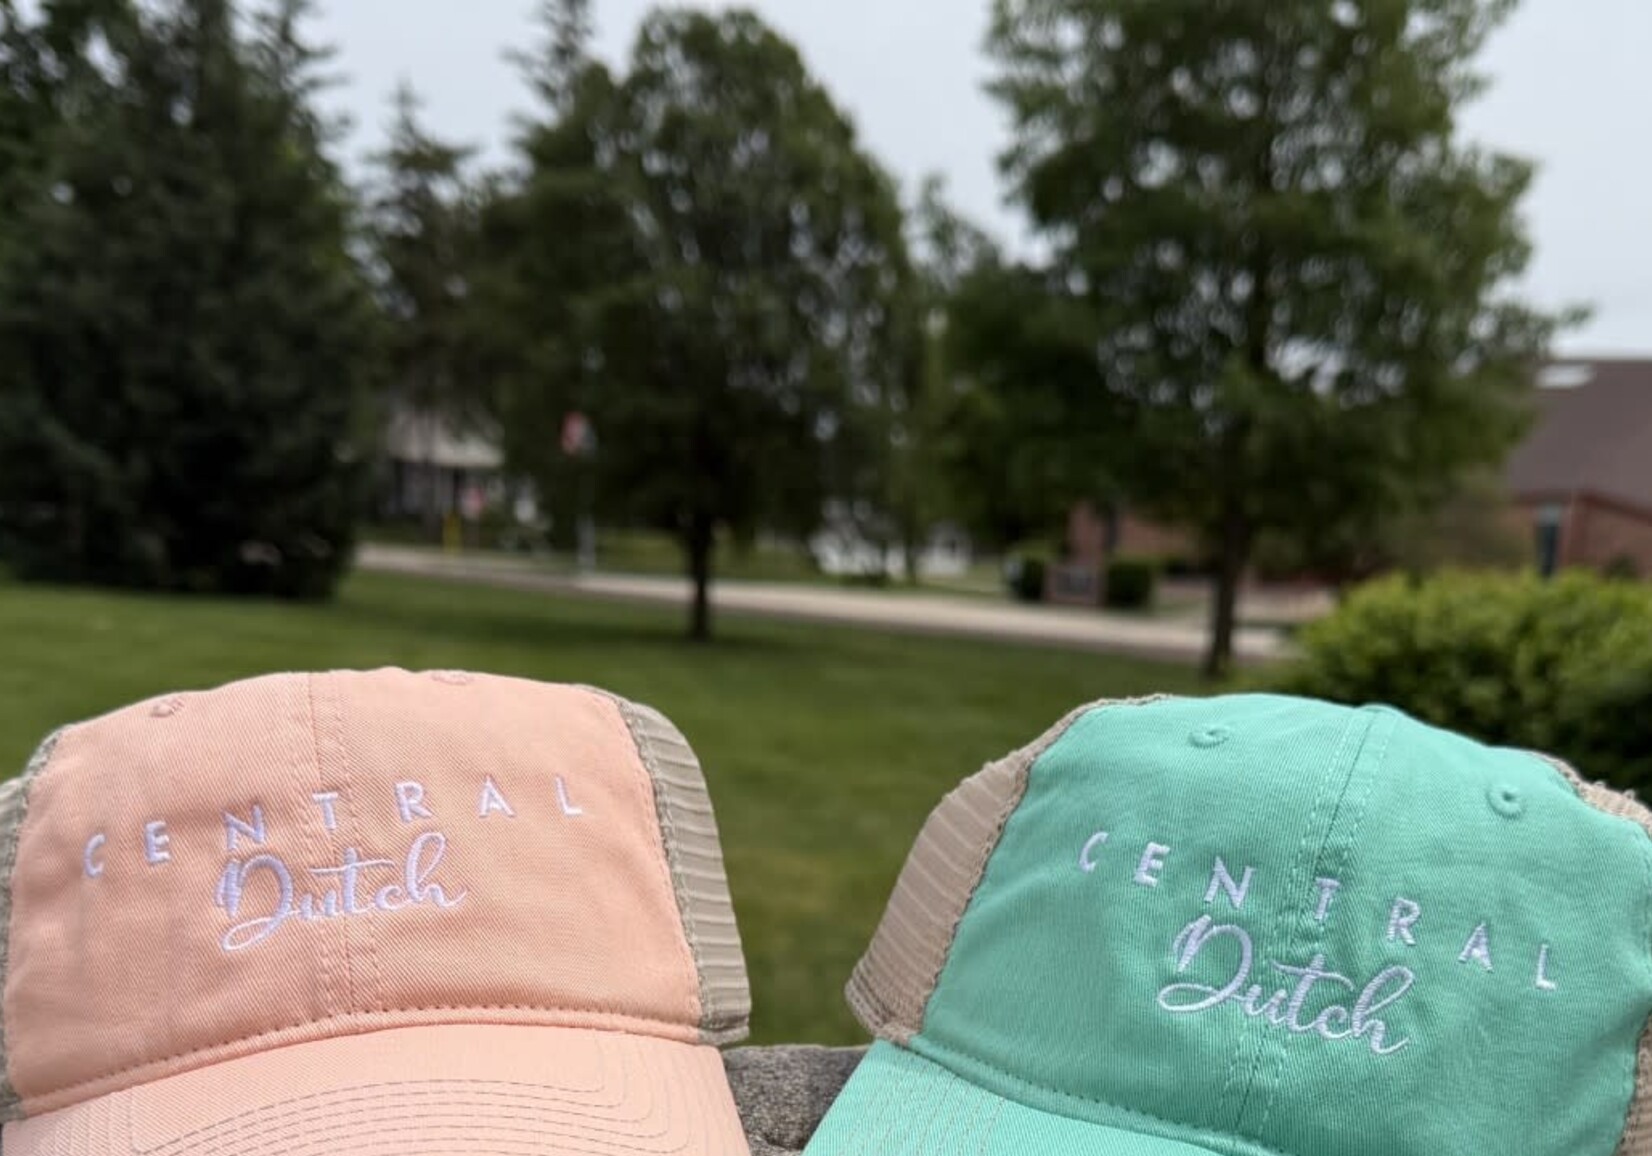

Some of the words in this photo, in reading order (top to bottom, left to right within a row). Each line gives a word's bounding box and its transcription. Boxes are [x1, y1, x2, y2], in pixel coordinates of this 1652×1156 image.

[84, 776, 583, 878] CENTRAL
[213, 831, 467, 952] Dutch
[1078, 831, 1557, 990] CENTRAL
[1157, 914, 1415, 1055] Dutch
